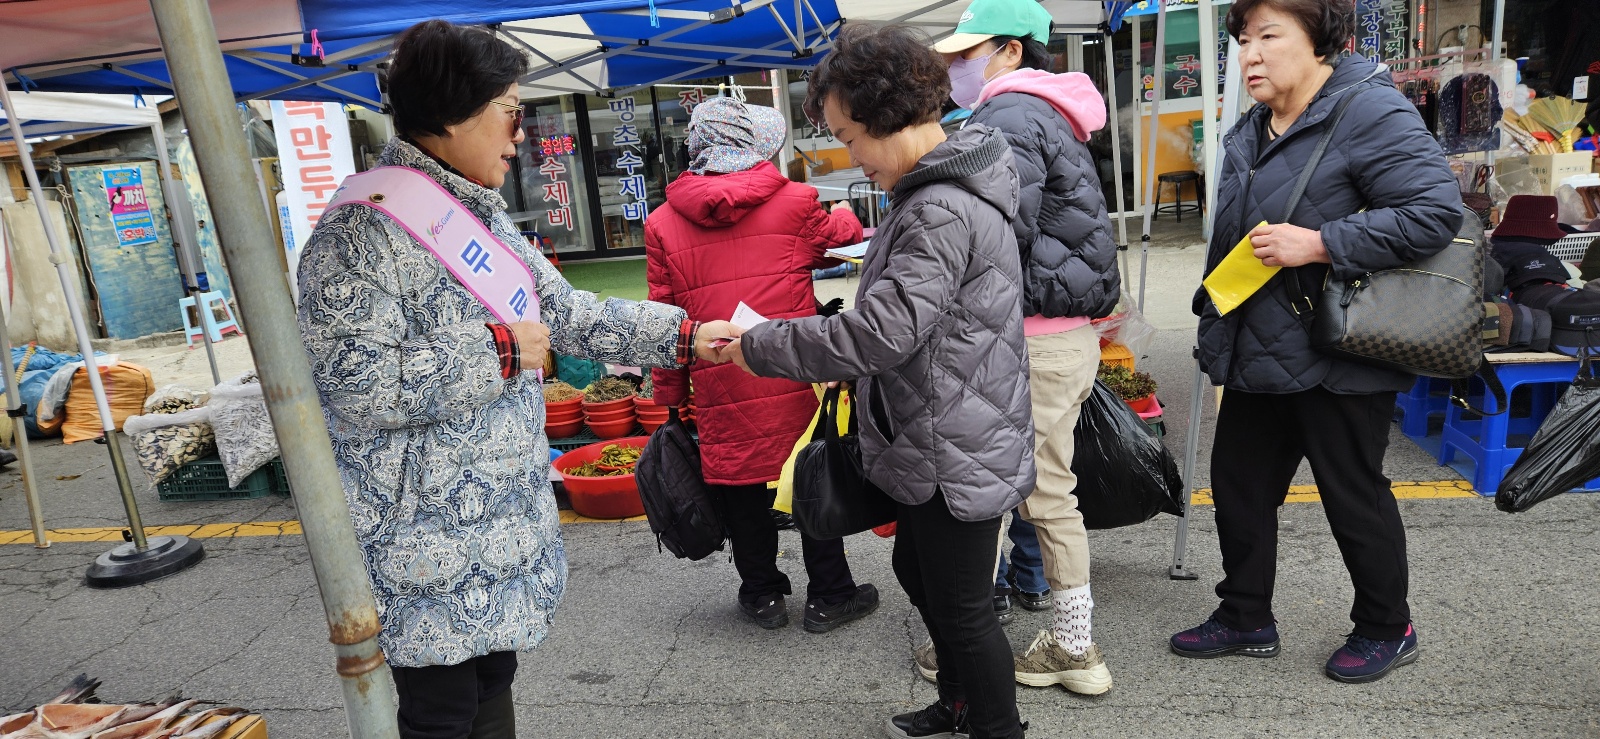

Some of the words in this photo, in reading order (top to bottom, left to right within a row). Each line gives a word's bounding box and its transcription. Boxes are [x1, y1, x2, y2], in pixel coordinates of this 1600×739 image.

[1173, 54, 1199, 95] 국수
[540, 135, 575, 155] 영업중
[608, 96, 649, 224] 땡초수제비
[122, 188, 145, 206] 까치
[539, 156, 573, 231] 수제비
